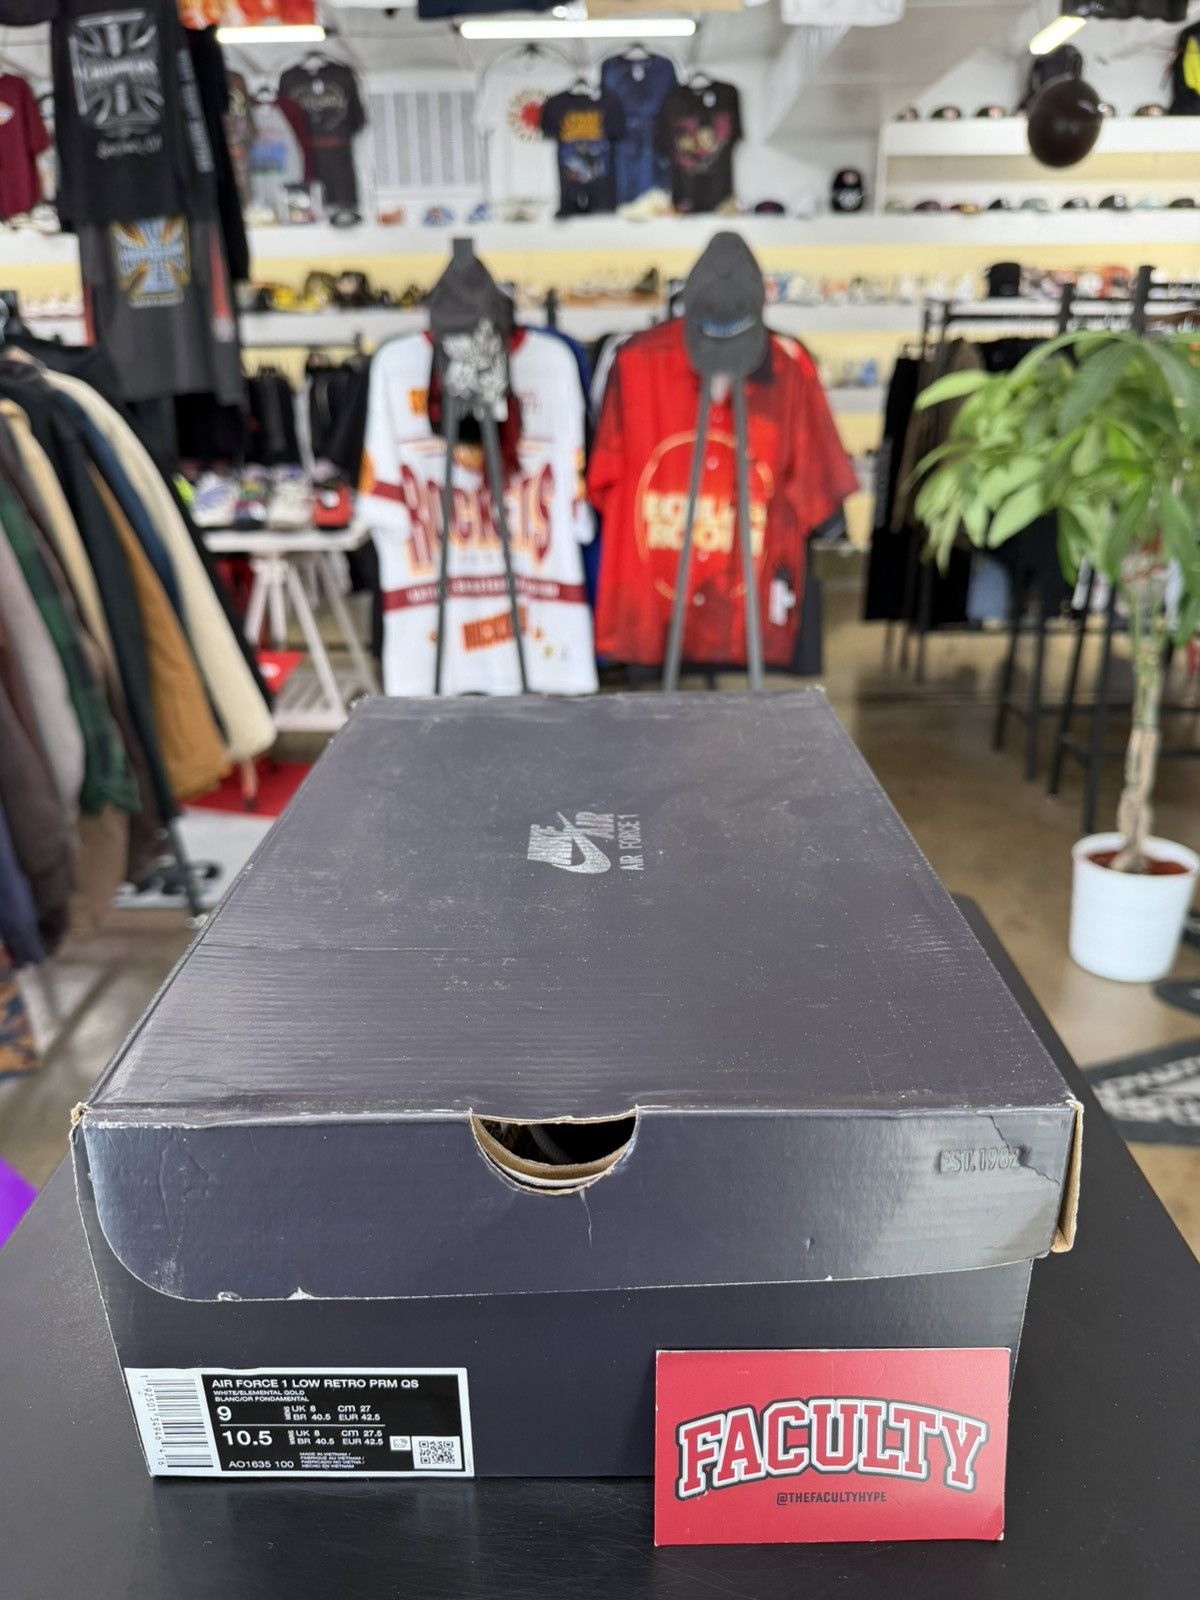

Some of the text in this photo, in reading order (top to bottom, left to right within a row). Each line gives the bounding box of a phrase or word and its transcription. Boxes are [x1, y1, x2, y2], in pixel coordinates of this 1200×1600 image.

[617, 820, 643, 850] FORCE
[619, 854, 644, 871] AIR
[937, 1146, 1021, 1173] EST. 1982
[212, 1379, 419, 1389] AIR FORCE 1 LOW RETRO PRM QS
[217, 1405, 232, 1422] 9
[311, 1413, 331, 1421] 40.5
[338, 1413, 359, 1421] EUR
[361, 1413, 381, 1421] 42.5
[222, 1430, 273, 1446] 10.5
[364, 1438, 384, 1446] 42.5
[675, 1396, 989, 1500] FACULTY
[228, 1460, 295, 1469] AO1635 100
[776, 1491, 888, 1506] @THEFACULTYHYPE
